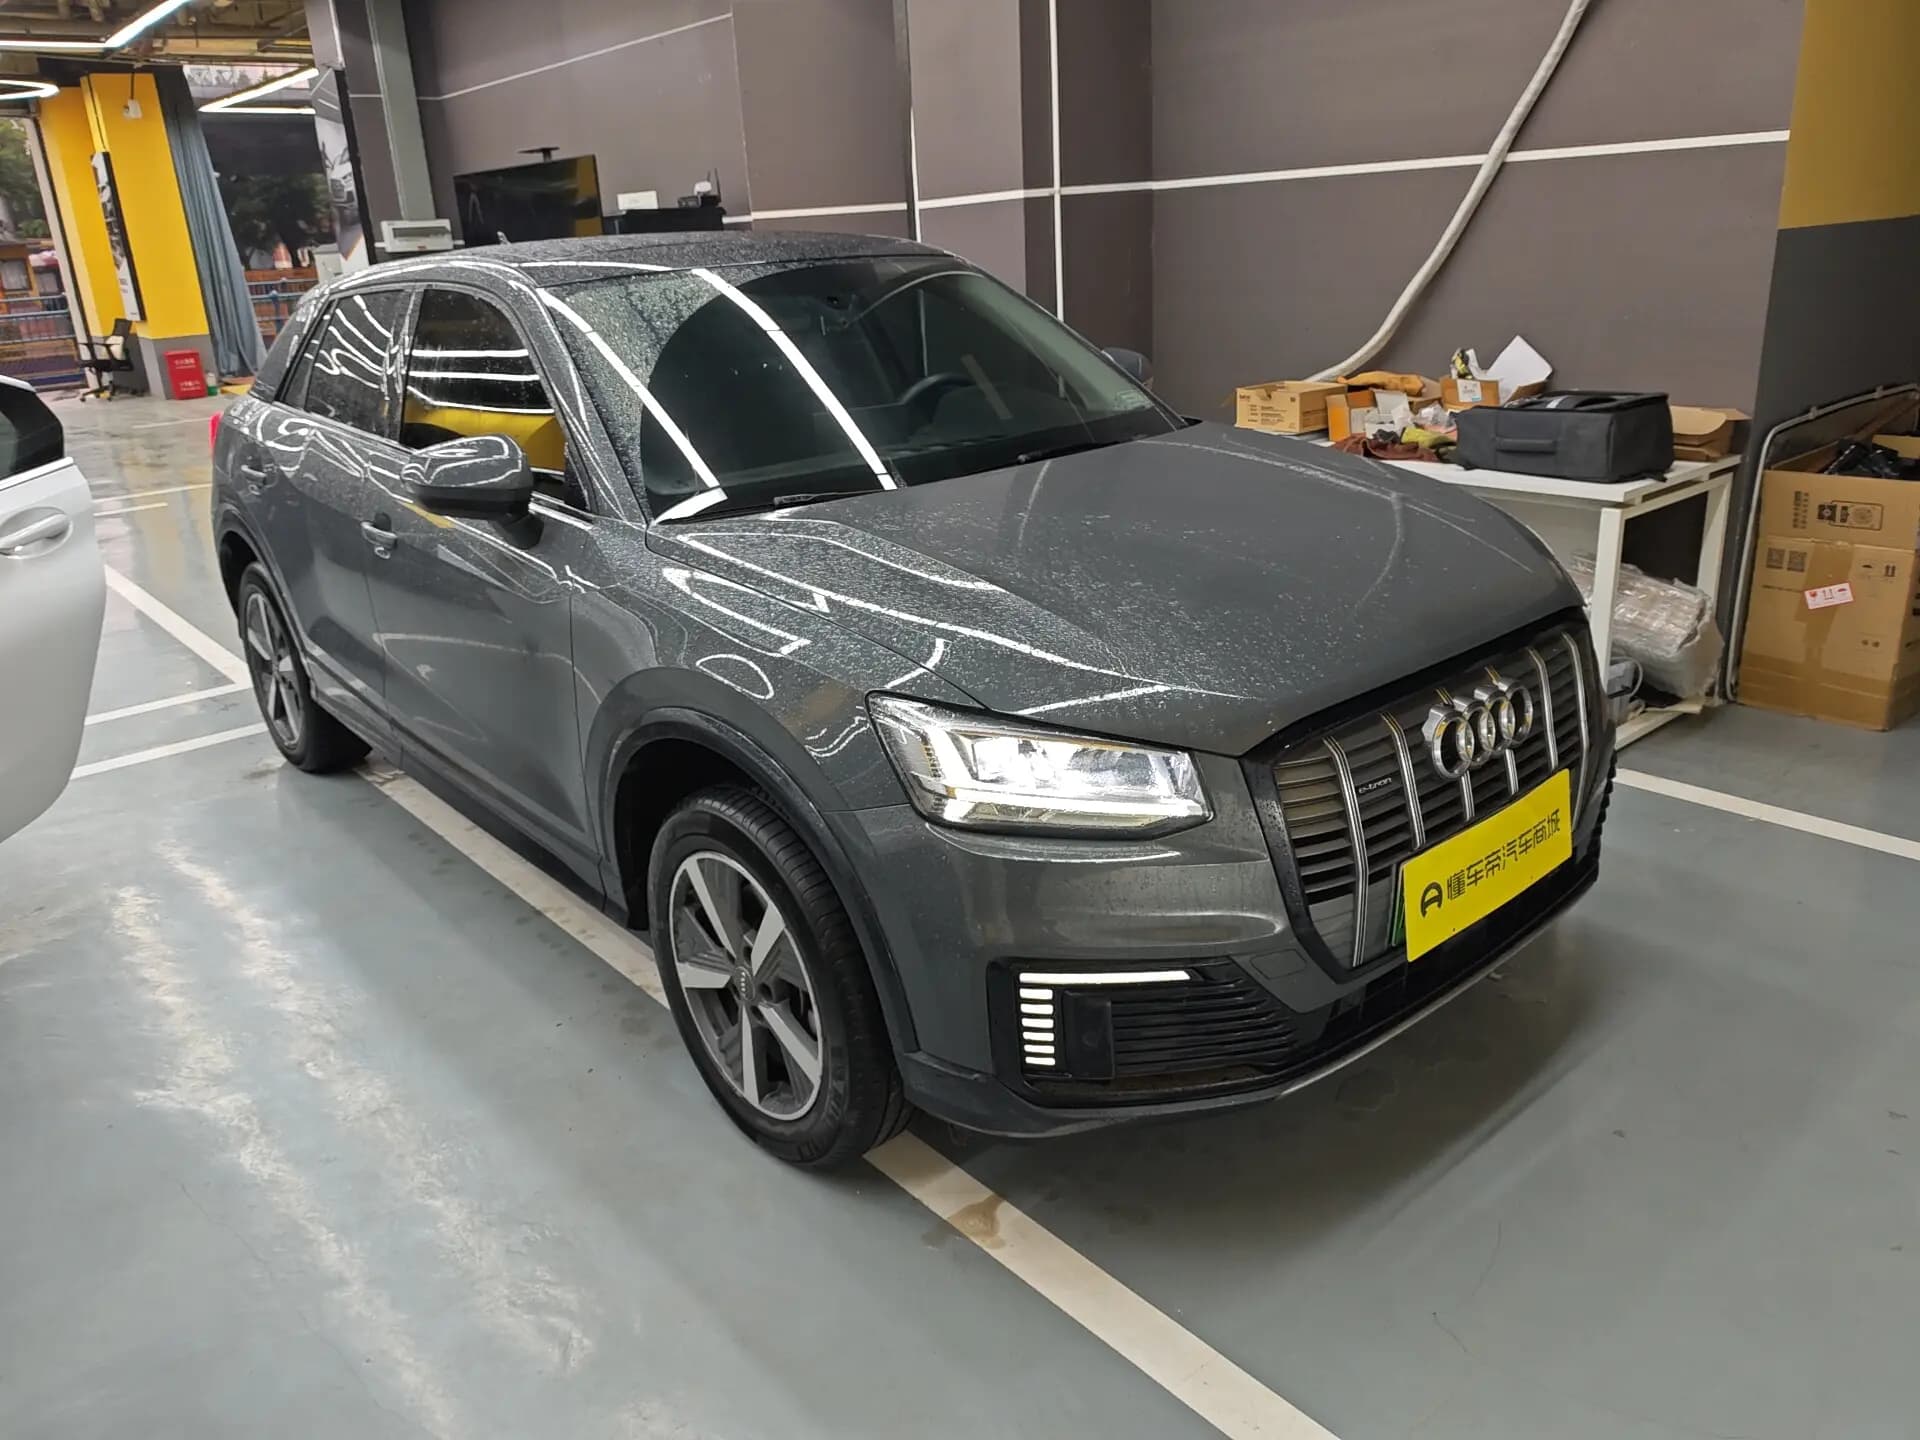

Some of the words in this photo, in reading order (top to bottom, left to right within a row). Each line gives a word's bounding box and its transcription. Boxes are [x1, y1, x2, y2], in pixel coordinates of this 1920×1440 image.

[1359, 777, 1393, 794] e-tron
[1447, 808, 1561, 900] 懂车帝汽车商城
